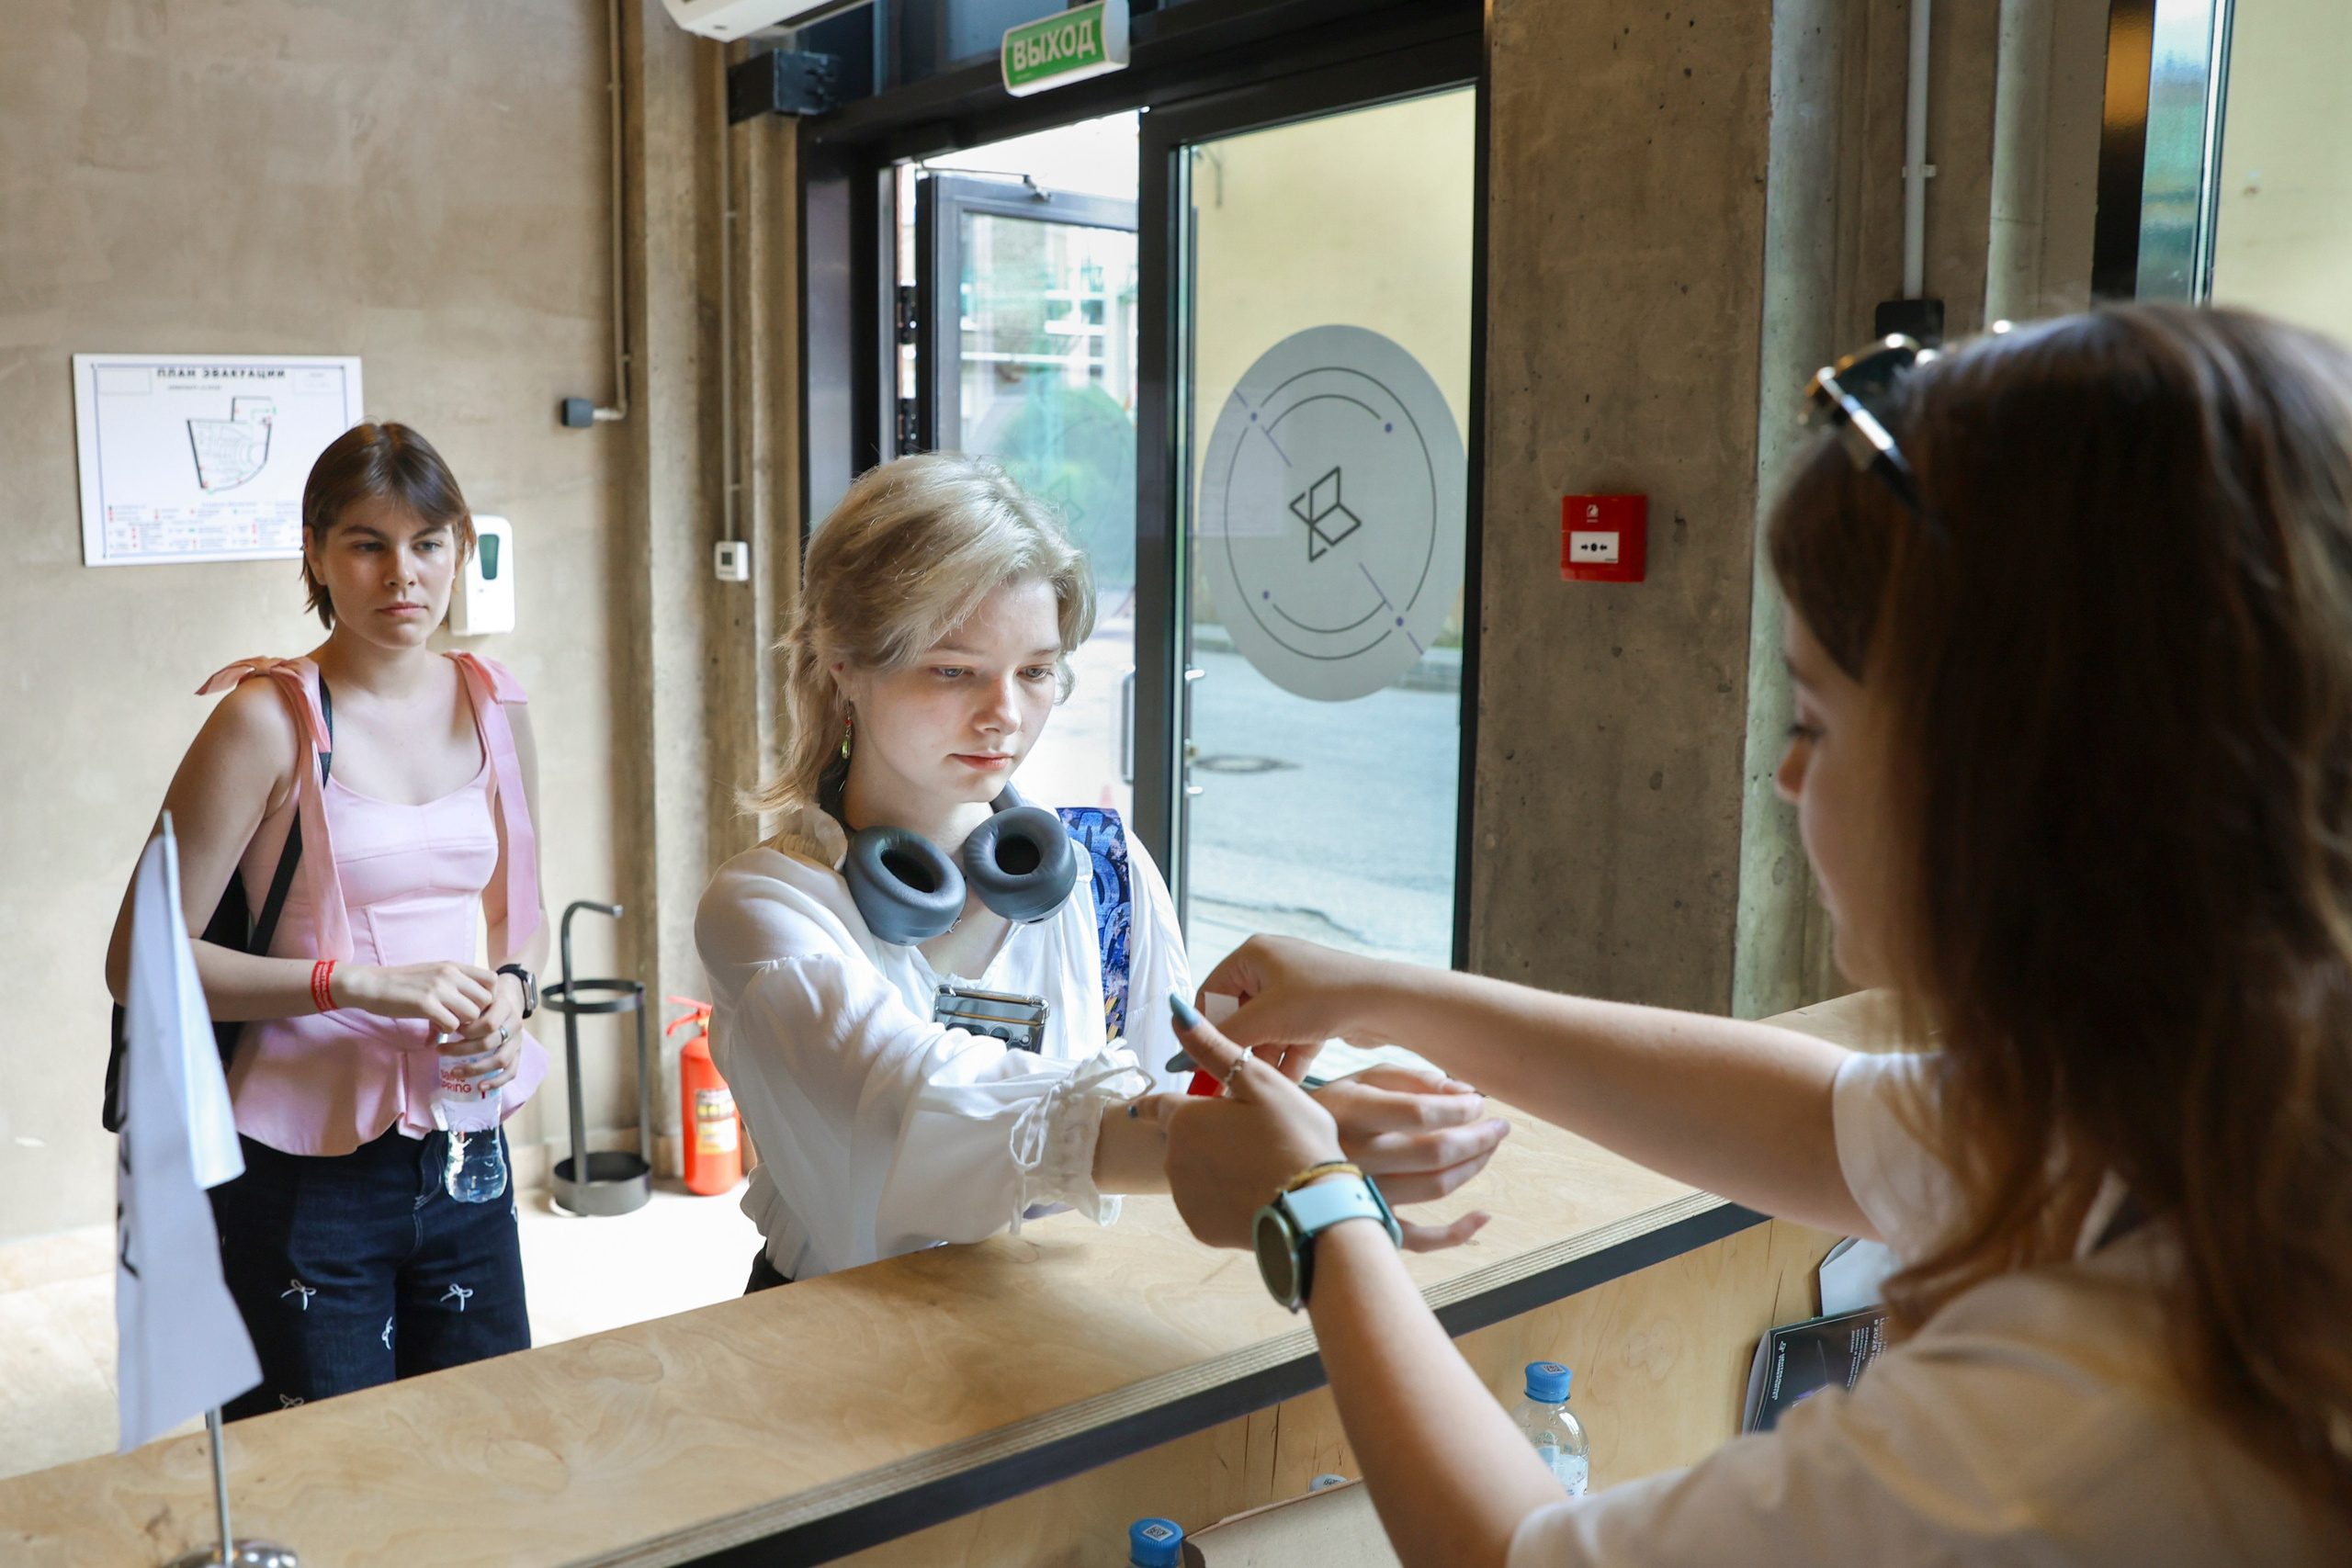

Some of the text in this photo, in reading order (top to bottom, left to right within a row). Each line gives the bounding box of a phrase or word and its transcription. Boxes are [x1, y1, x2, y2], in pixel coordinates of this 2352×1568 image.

[1013, 19, 1097, 73] ВЫХОД
[157, 369, 285, 378] ПЛАН ЭВАКУАЦИИ
